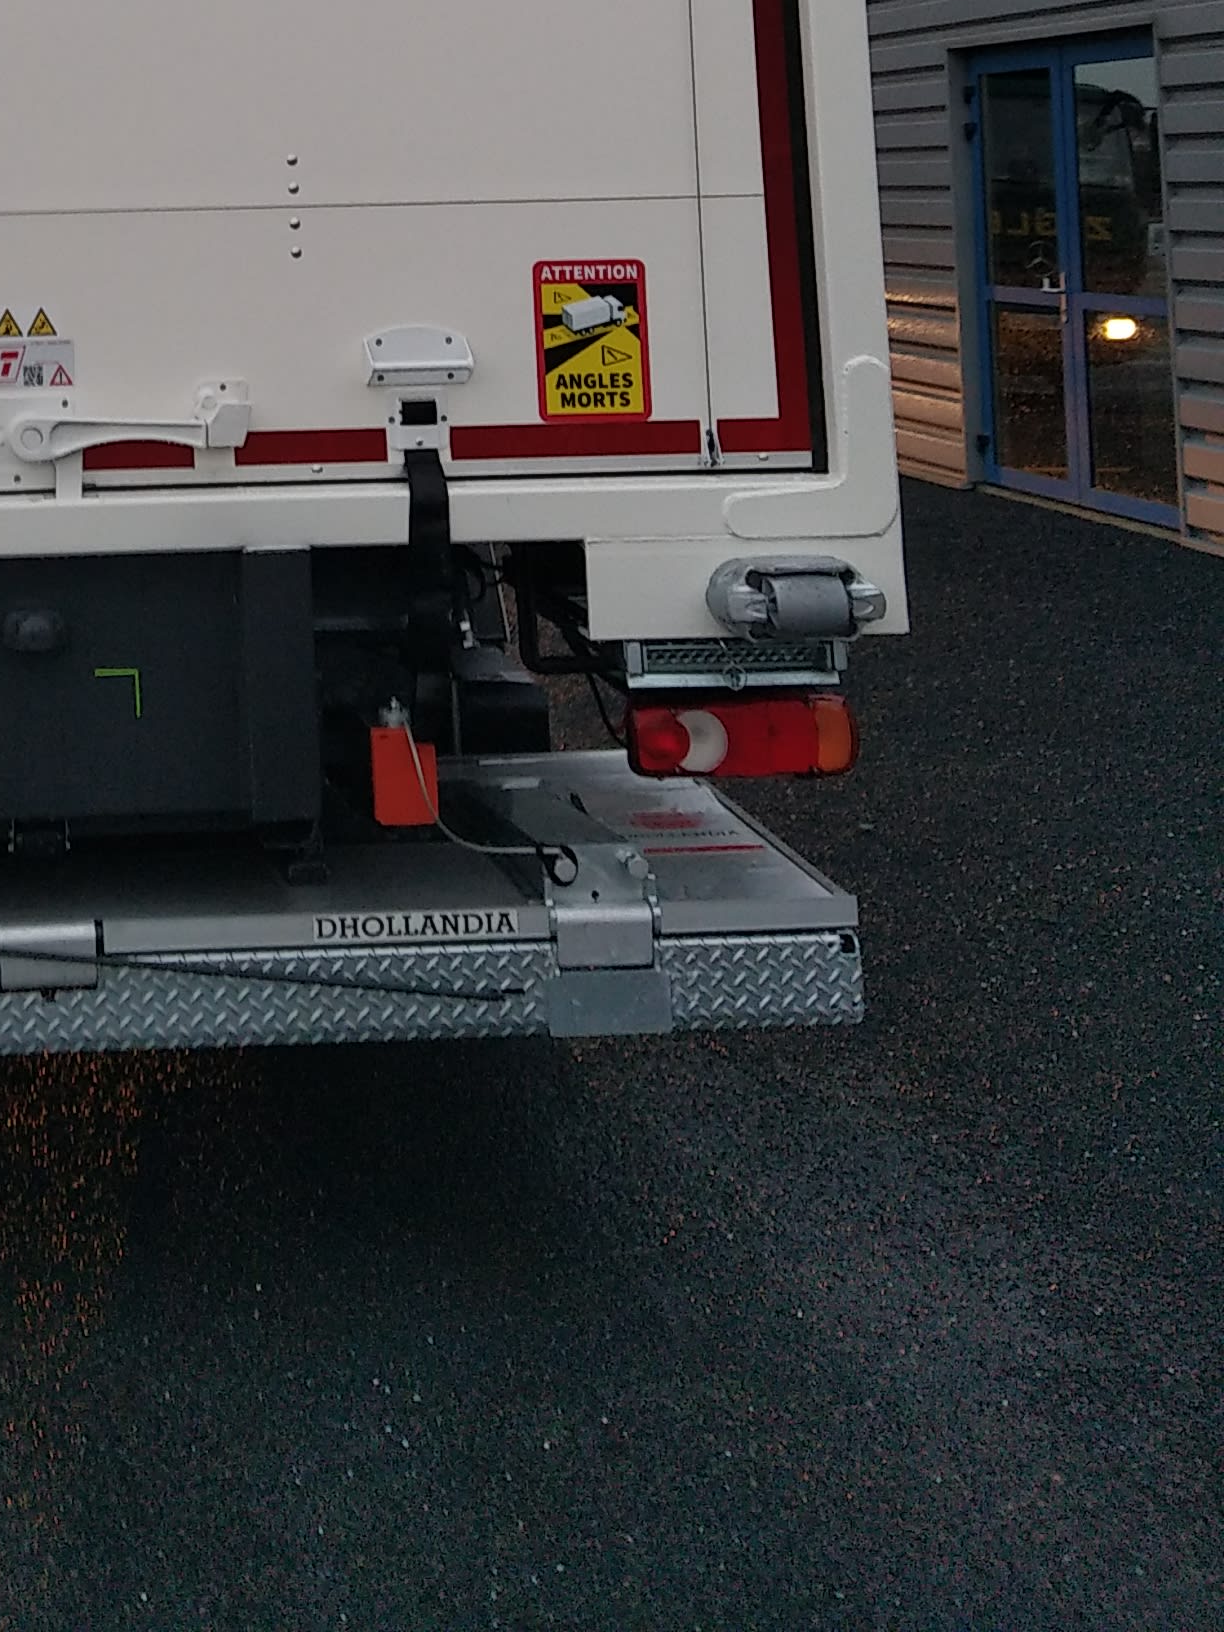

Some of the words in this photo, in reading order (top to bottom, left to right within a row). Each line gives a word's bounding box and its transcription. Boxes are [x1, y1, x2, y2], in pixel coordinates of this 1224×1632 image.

[541, 264, 638, 281] ATTENTION
[555, 372, 634, 390] ANGLES
[560, 391, 631, 409] MORTS
[316, 912, 517, 940] DHOLLANDIA
